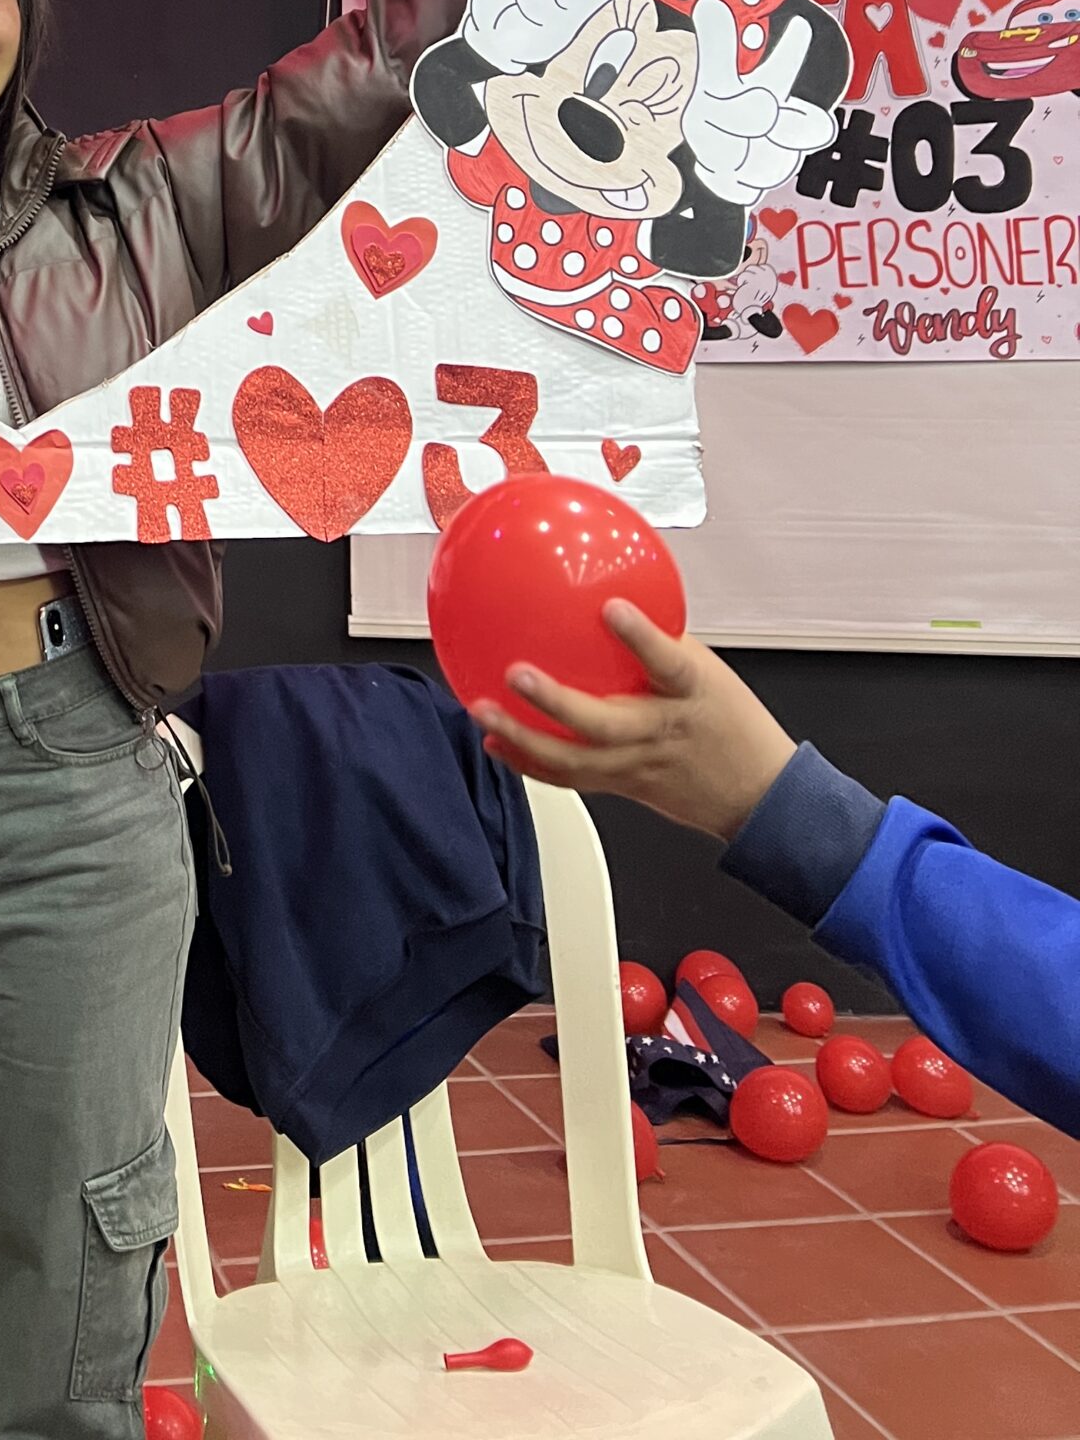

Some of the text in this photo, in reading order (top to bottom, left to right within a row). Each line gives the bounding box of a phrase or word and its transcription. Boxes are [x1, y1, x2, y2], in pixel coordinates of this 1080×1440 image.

[796, 100, 1034, 214] #03
[797, 215, 1080, 290] PERSONER
[863, 286, 1022, 359] Wendy
